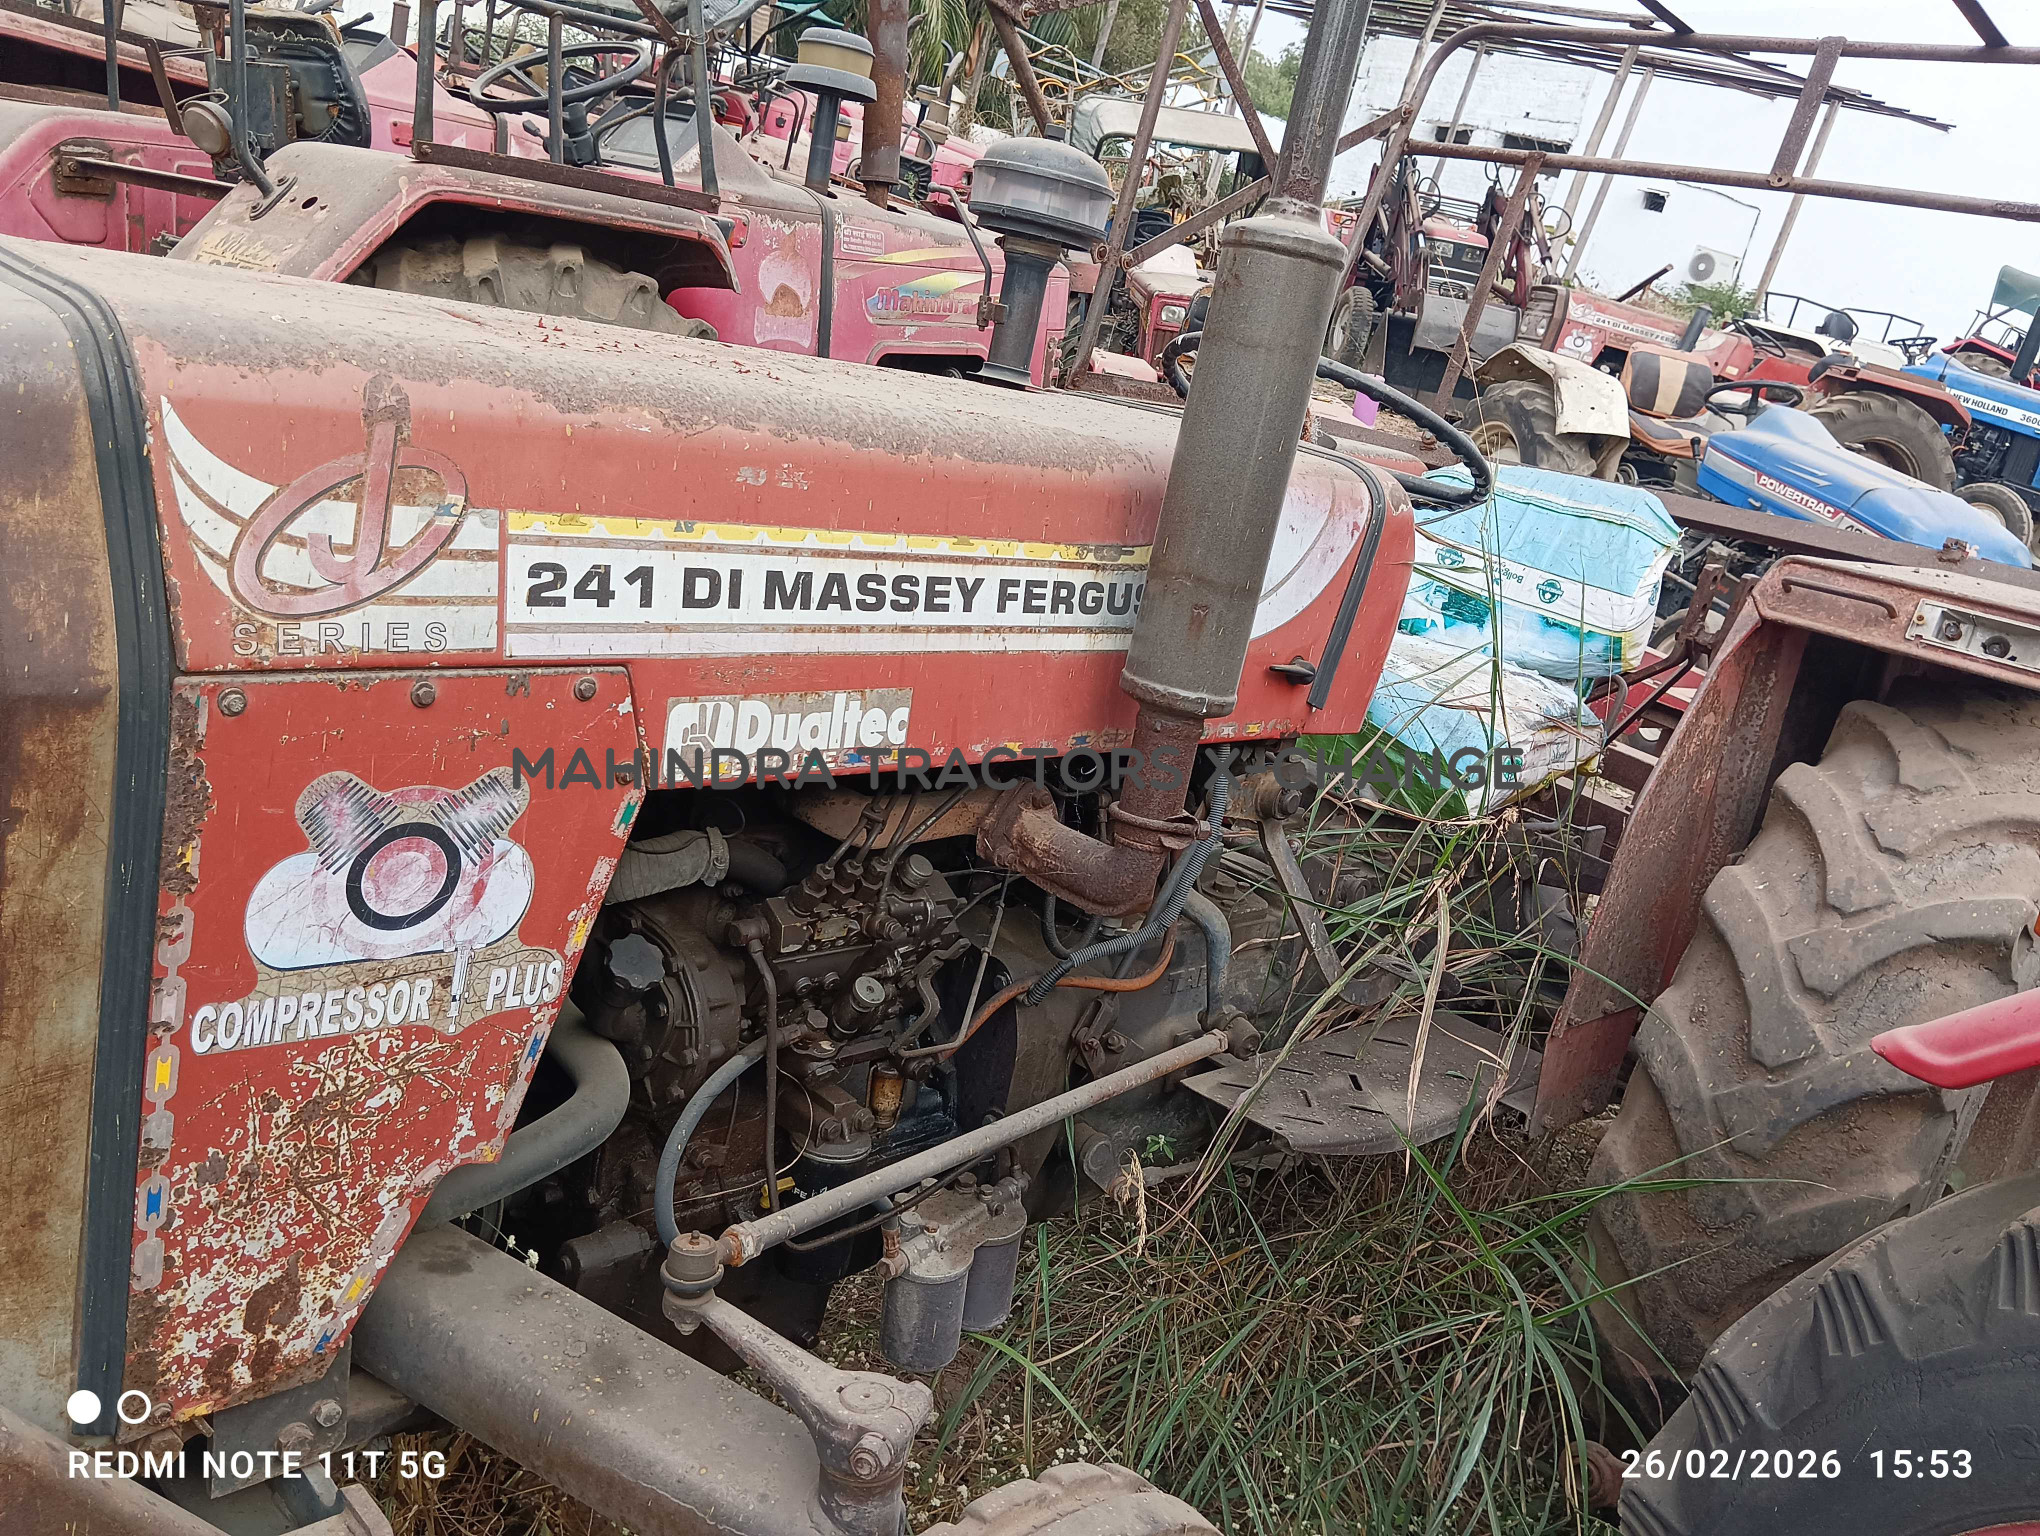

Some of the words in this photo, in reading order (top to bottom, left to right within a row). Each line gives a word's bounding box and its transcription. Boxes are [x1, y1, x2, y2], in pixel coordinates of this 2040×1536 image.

[877, 287, 974, 315] Mahindra
[1622, 325, 1654, 338] MASSEY
[1971, 398, 2009, 416] HOLLAND
[1759, 475, 1835, 518] POWERTRAC
[526, 561, 654, 608] 241
[681, 567, 744, 610] DI
[763, 570, 986, 614] MASSEY
[232, 622, 448, 656] SERIES
[190, 977, 434, 1055] COMPRESSOR
[486, 959, 563, 1011] PLUS
